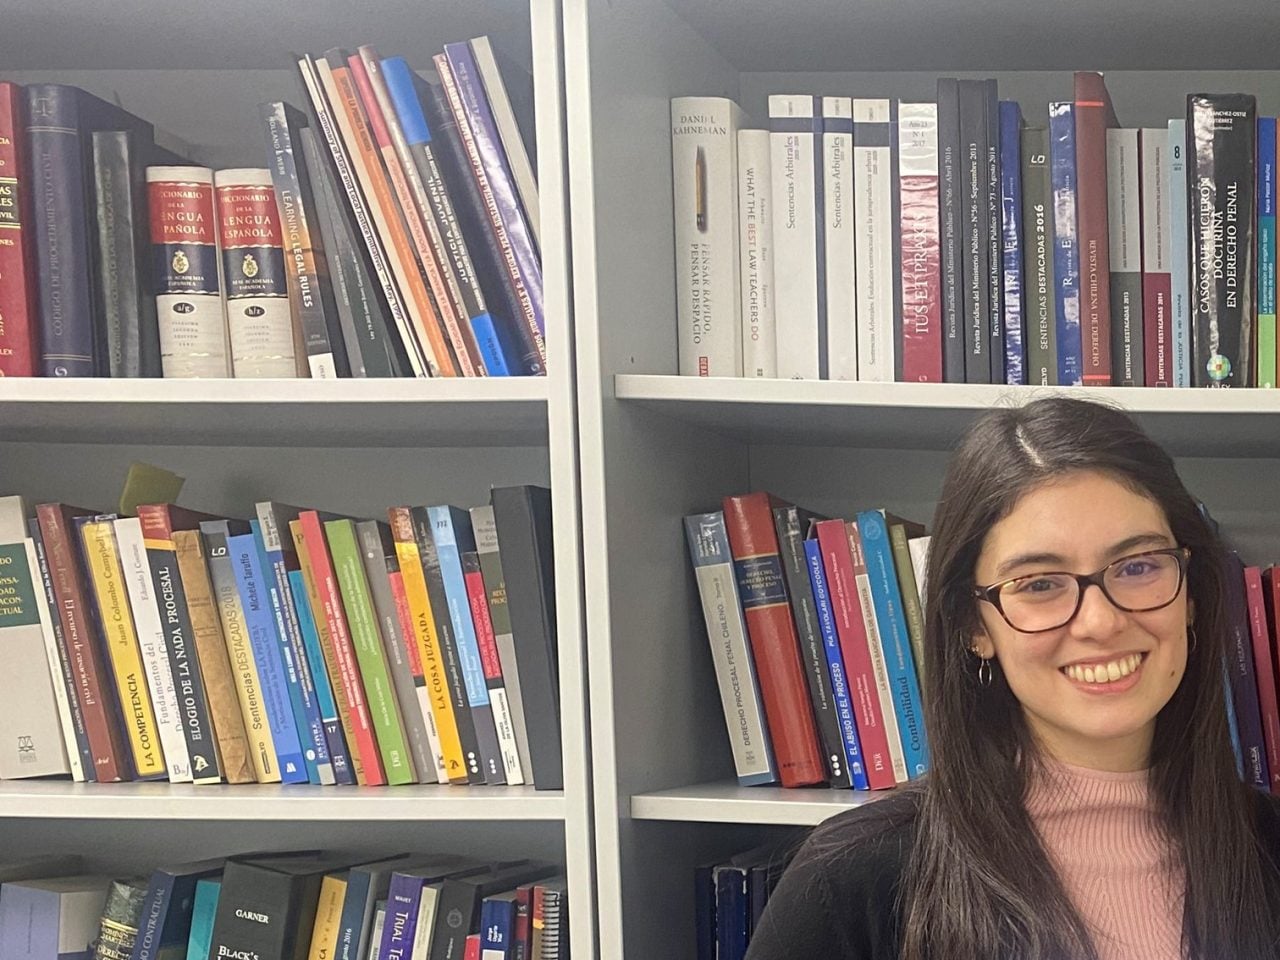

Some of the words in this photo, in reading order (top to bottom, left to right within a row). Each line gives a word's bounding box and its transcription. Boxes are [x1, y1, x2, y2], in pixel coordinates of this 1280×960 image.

[316, 110, 336, 146] Summary
[335, 154, 347, 174] State
[342, 174, 352, 190] and
[348, 189, 360, 210] Local
[356, 210, 370, 235] Justice
[365, 235, 383, 271] Initiatives
[391, 301, 402, 320] 1999
[1034, 204, 1044, 232] 2016
[1200, 177, 1210, 240] HICIERON
[1227, 181, 1236, 221] PENAL
[282, 190, 299, 240] LEARNING
[292, 242, 305, 274] LEGAL
[299, 275, 312, 307] RULES
[1036, 234, 1046, 293] DESTACADAS
[1199, 242, 1209, 270] QUE
[1213, 210, 1223, 278] DOCTRINA
[1226, 224, 1236, 286] DERECHO
[1199, 274, 1209, 312] CASOS
[1226, 290, 1236, 307] EN
[1038, 296, 1048, 349] SENTENCIAS
[159, 566, 178, 624] PROCESAL
[171, 627, 186, 659] NADA
[417, 612, 435, 662] JUZGADA
[177, 661, 189, 676] LA
[180, 678, 193, 695] DE
[429, 664, 442, 693] COSA
[126, 672, 150, 750] COMPETENCIA
[184, 696, 201, 740] ELOGIO
[436, 695, 445, 709] LA
[144, 752, 154, 767] LA
[234, 909, 269, 923] GARNER
